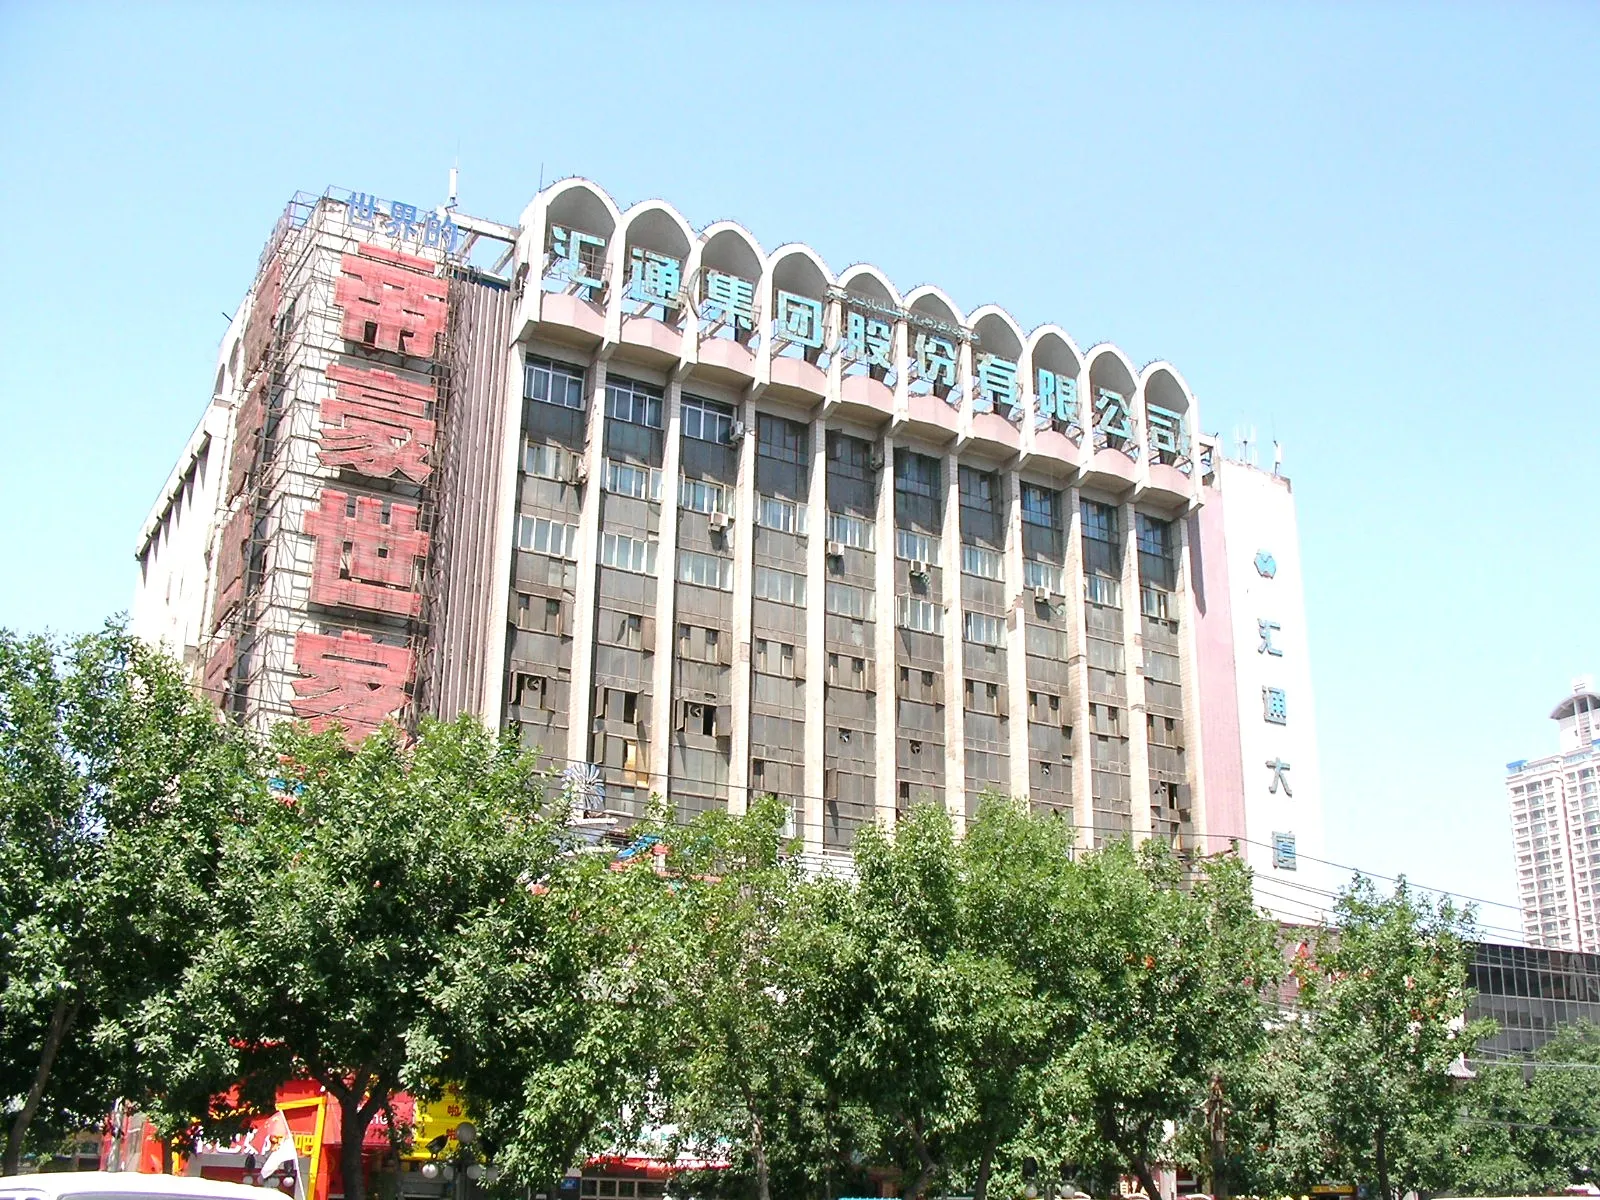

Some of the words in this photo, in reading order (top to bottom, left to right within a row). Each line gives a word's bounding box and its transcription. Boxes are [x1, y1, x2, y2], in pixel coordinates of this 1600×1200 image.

[345, 192, 459, 251] 世界的
[551, 226, 1190, 457] 汇通集团股份有限公司
[289, 241, 450, 750] 帝豪世家
[1257, 617, 1297, 872] 汇通大厦
